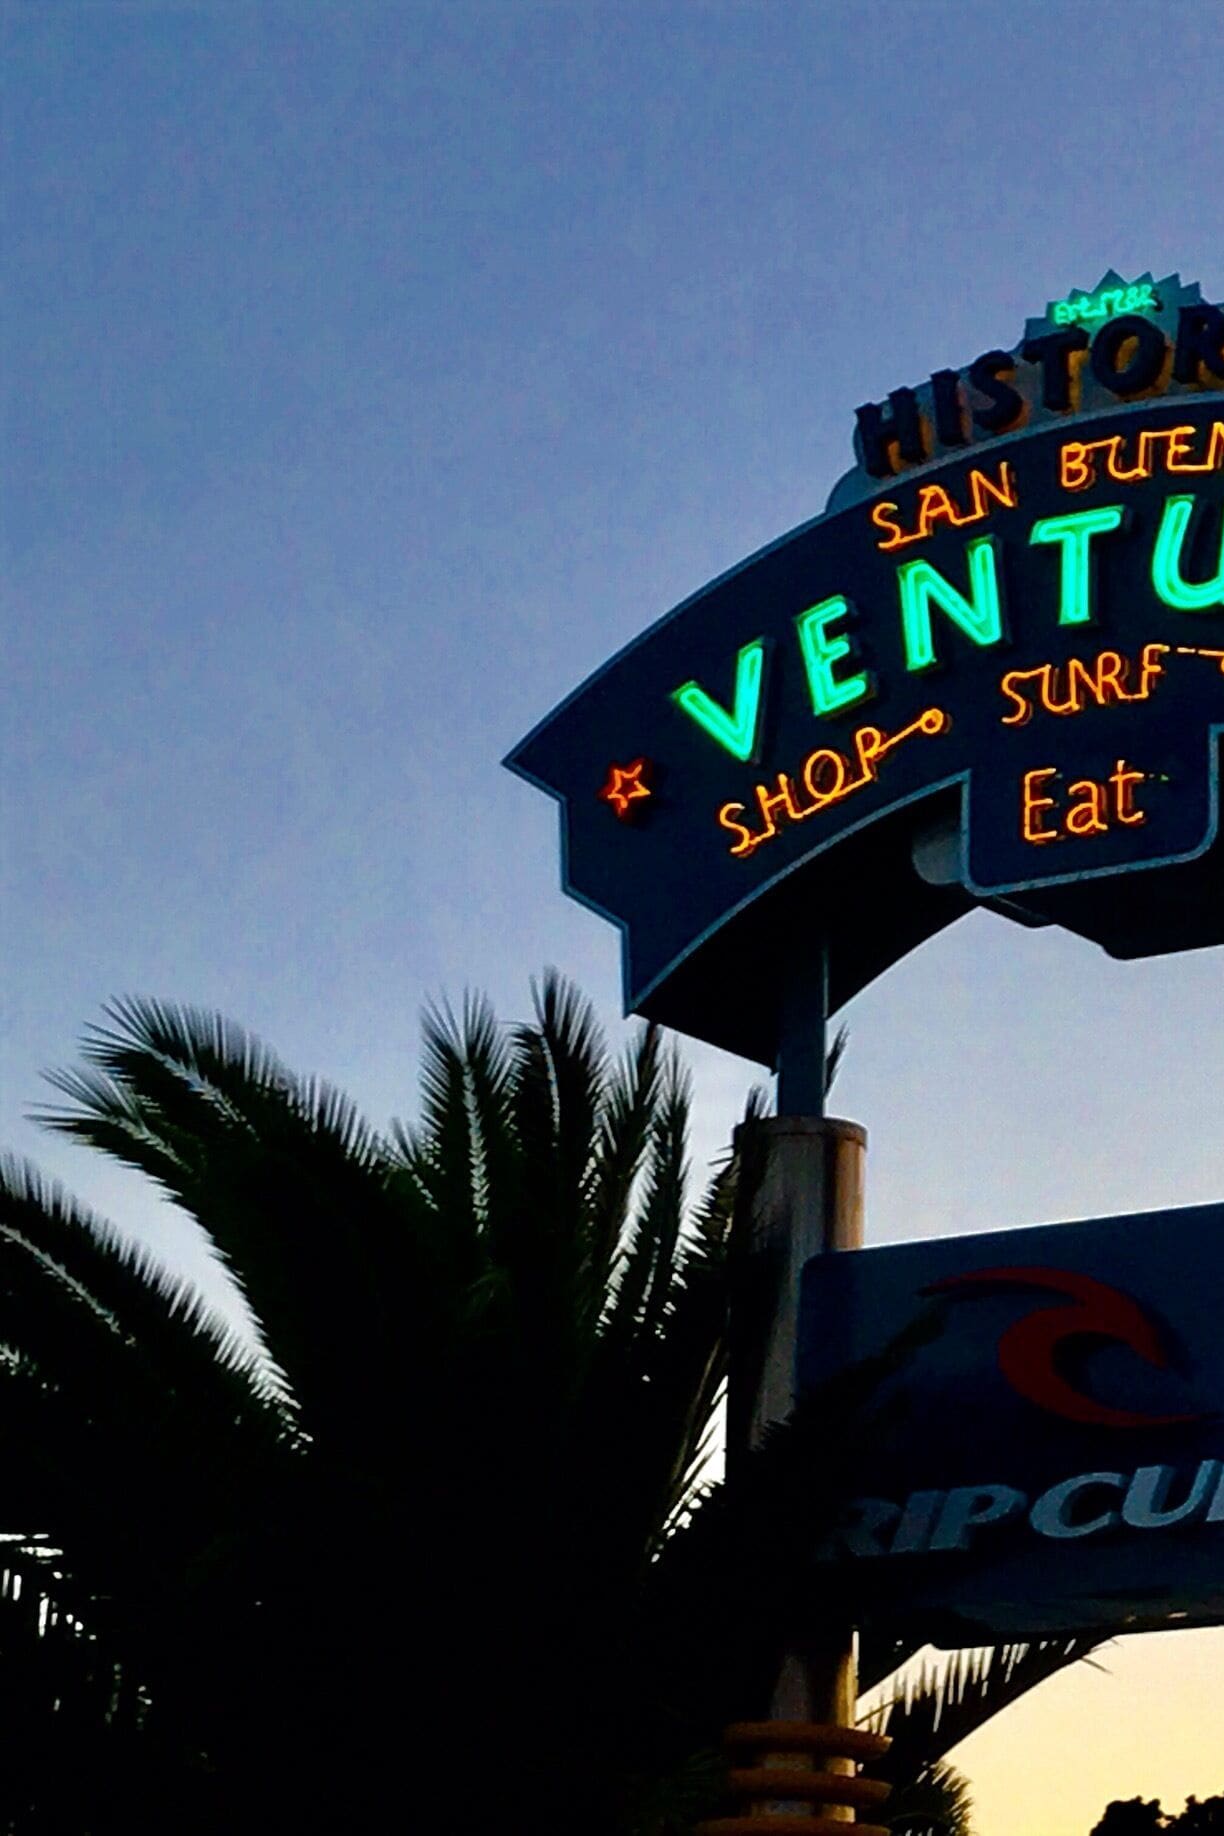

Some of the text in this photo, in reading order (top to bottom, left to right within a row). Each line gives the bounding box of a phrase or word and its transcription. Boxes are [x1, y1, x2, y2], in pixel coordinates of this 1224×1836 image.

[871, 462, 1016, 551] SAN
[719, 726, 880, 853] SHOP
[1001, 643, 1168, 723] SURF
[1023, 759, 1144, 842] Eat
